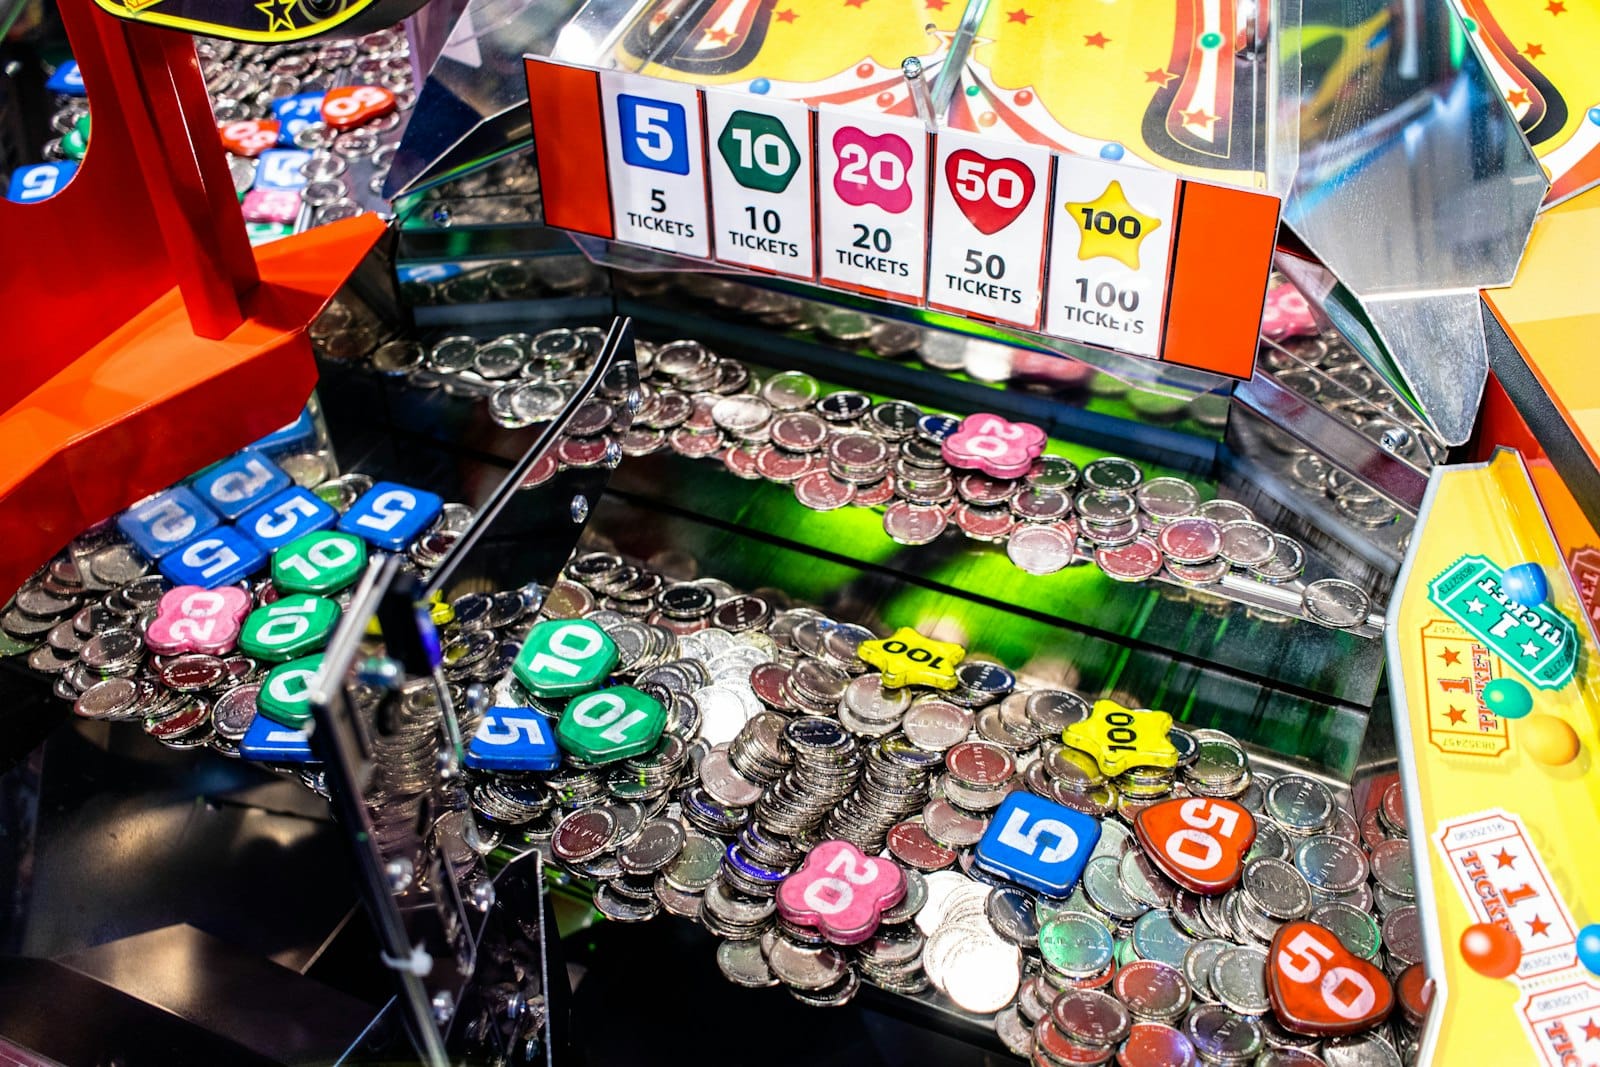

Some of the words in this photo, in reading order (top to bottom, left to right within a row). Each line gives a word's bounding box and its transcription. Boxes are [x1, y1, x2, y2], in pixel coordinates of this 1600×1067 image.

[635, 104, 673, 162] 5
[732, 128, 791, 177] 10
[21, 165, 59, 200] 5
[839, 143, 905, 191] 20
[955, 158, 1025, 209] 50
[650, 188, 667, 213] 5
[745, 206, 781, 234] 10
[627, 212, 695, 238] TICKETS
[852, 223, 892, 253] 20
[1081, 207, 1141, 240] 100
[728, 231, 799, 258] TICKETS
[836, 249, 909, 277] TICKETS
[963, 249, 1006, 280] 50
[945, 274, 1022, 304] TICKETS
[1075, 277, 1140, 313] 100
[965, 418, 1024, 458] 20
[255, 495, 320, 539] 5
[357, 490, 417, 532] 5
[181, 539, 241, 579] 5
[279, 538, 357, 580] 10
[168, 592, 225, 641] 20
[255, 599, 318, 646] 10
[1488, 611, 1521, 639] 1
[528, 624, 603, 677] 10
[882, 640, 944, 669] 100
[1437, 676, 1474, 694] 1
[476, 716, 545, 745] 5
[573, 693, 649, 744] 10
[1107, 712, 1137, 753] 100
[997, 807, 1080, 864] 5
[1165, 798, 1239, 870] 50
[803, 848, 879, 914] 20
[1460, 849, 1517, 934] TICK
[1500, 882, 1540, 908] 1
[1278, 930, 1376, 1019] 50
